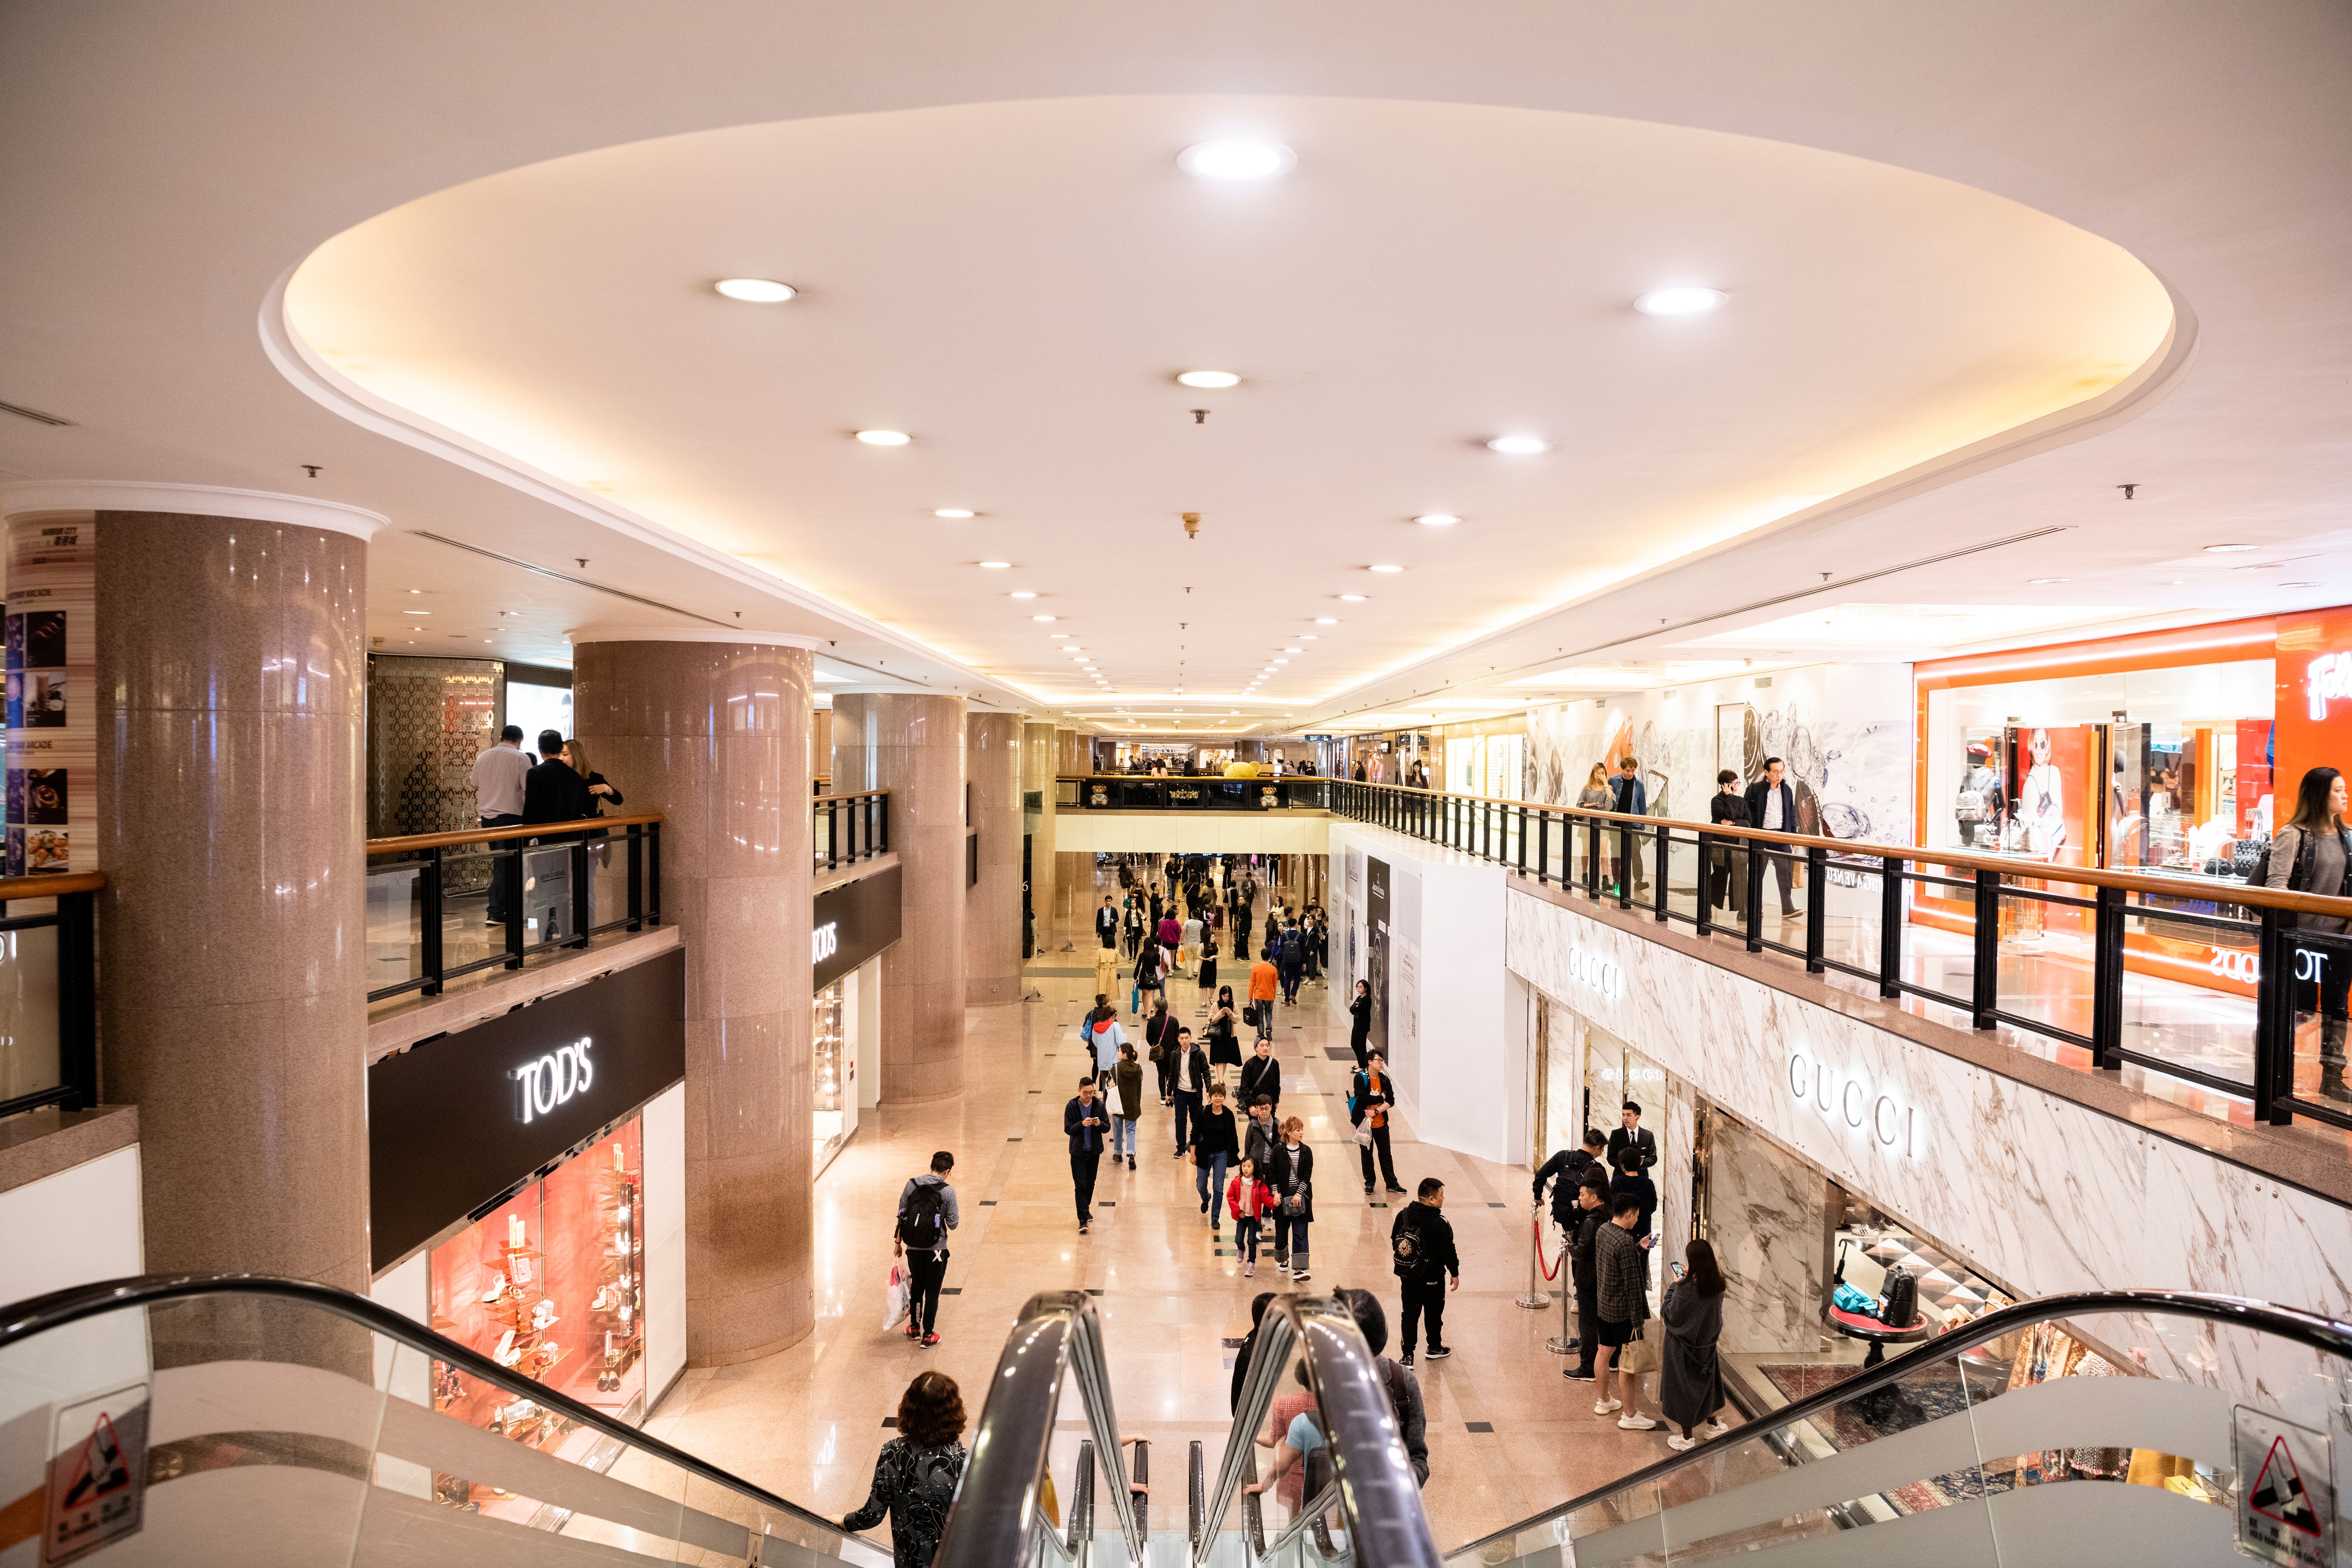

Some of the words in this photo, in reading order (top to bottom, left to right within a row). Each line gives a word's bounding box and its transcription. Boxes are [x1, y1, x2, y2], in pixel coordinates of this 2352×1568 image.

[812, 922, 836, 964] TOD'S
[1569, 947, 1619, 998] GUCCI
[517, 1037, 592, 1124] TOD'S
[1604, 1069, 1661, 1080] GUCCI
[1790, 1054, 1914, 1158] GUCCI
[932, 1250, 942, 1262] X
